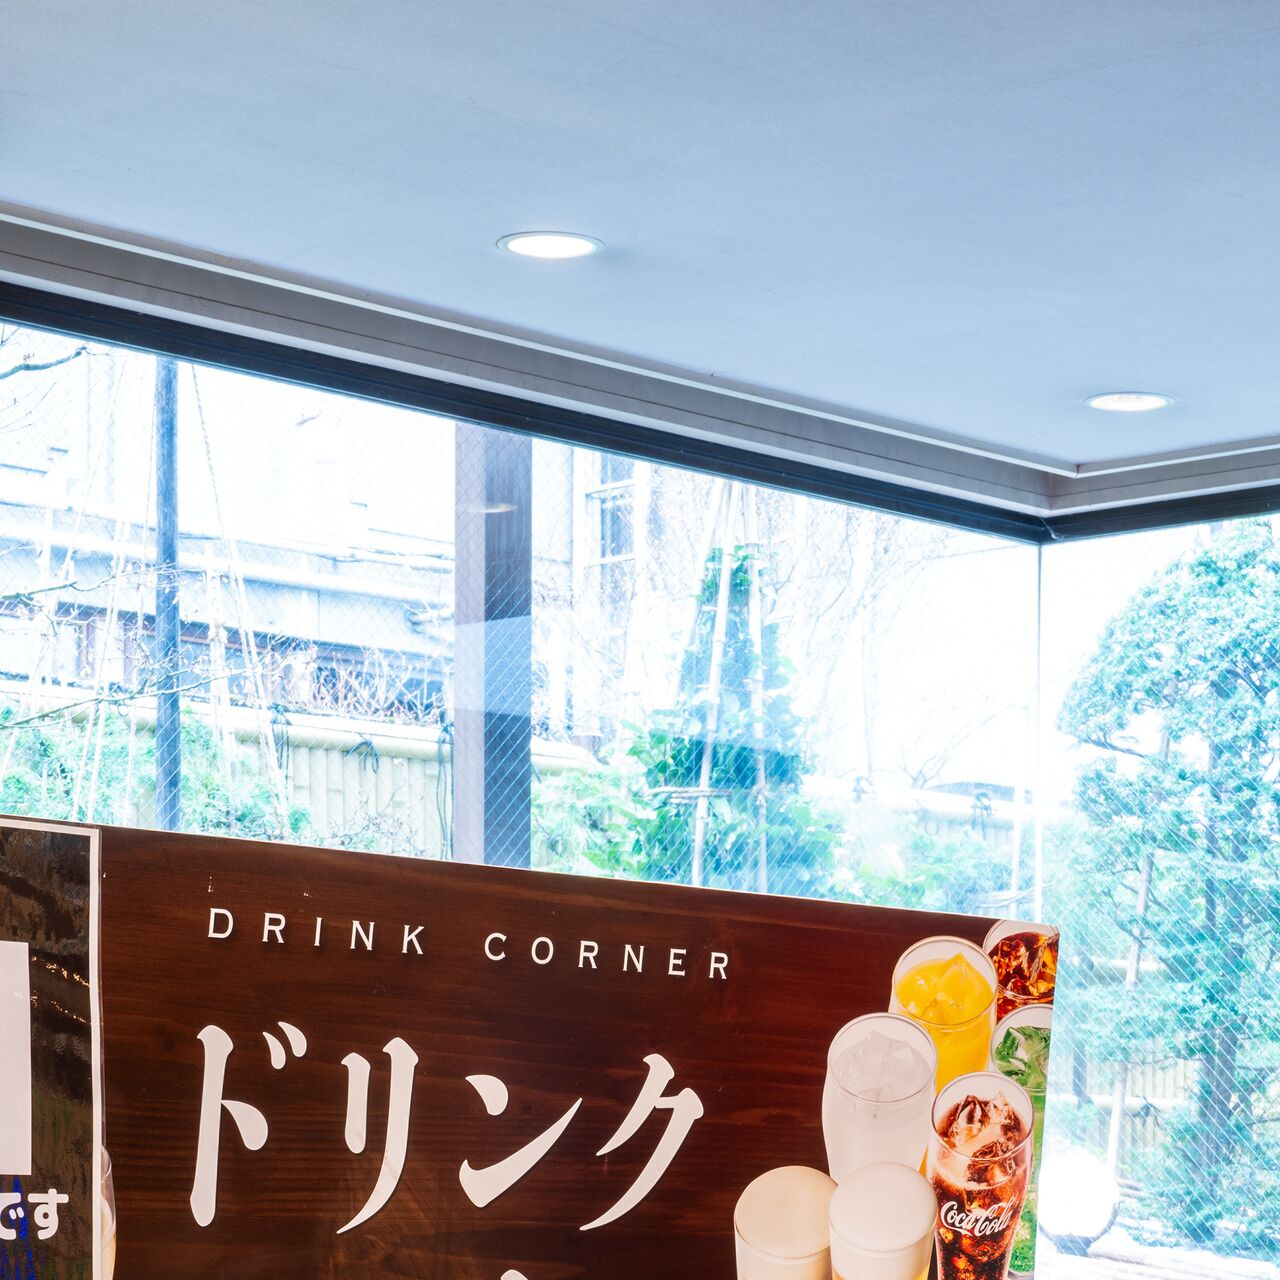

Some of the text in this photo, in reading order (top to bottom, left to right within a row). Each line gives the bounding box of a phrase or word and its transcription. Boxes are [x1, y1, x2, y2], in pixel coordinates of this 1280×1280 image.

[207, 907, 730, 980] DRINK CORNER
[189, 1020, 705, 1235] ドリンク
